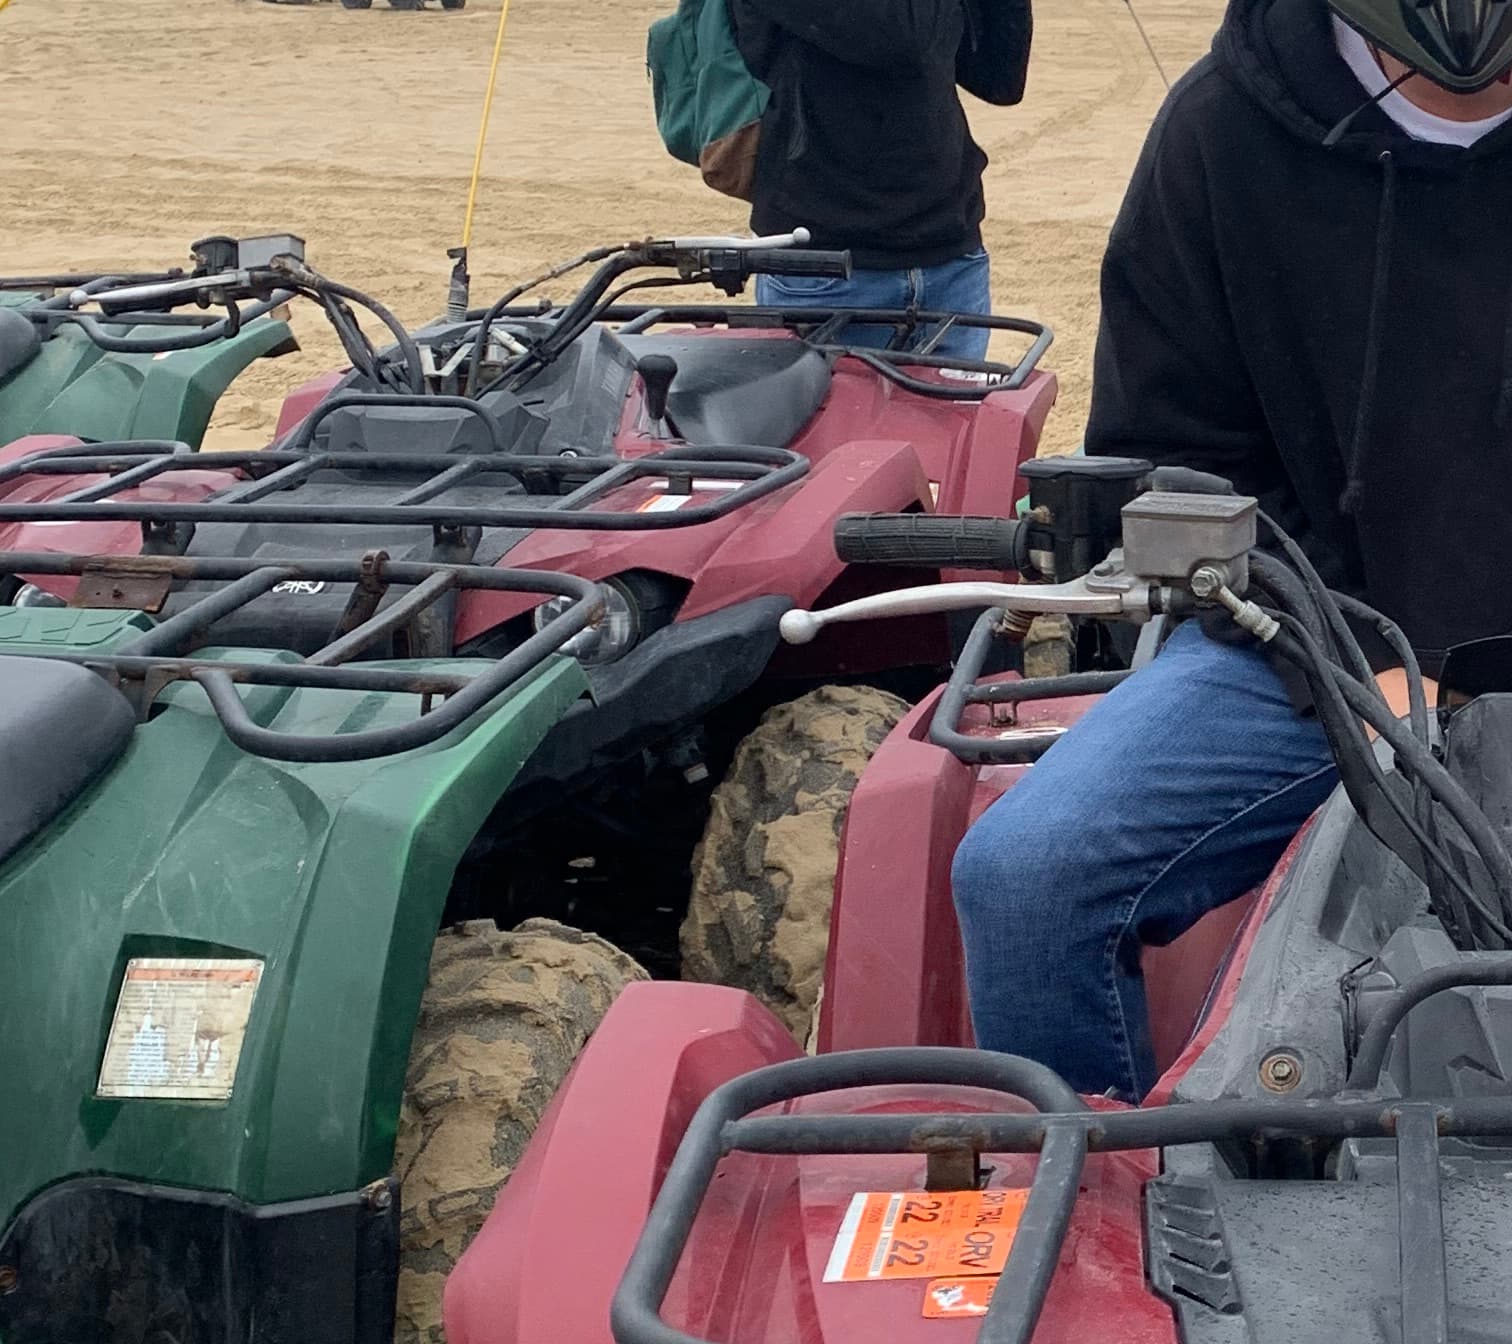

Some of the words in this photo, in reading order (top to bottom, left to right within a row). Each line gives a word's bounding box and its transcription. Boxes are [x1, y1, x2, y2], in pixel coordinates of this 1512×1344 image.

[901, 1200, 942, 1224] 22
[886, 1239, 929, 1268] 22
[959, 1231, 996, 1269] ORV
